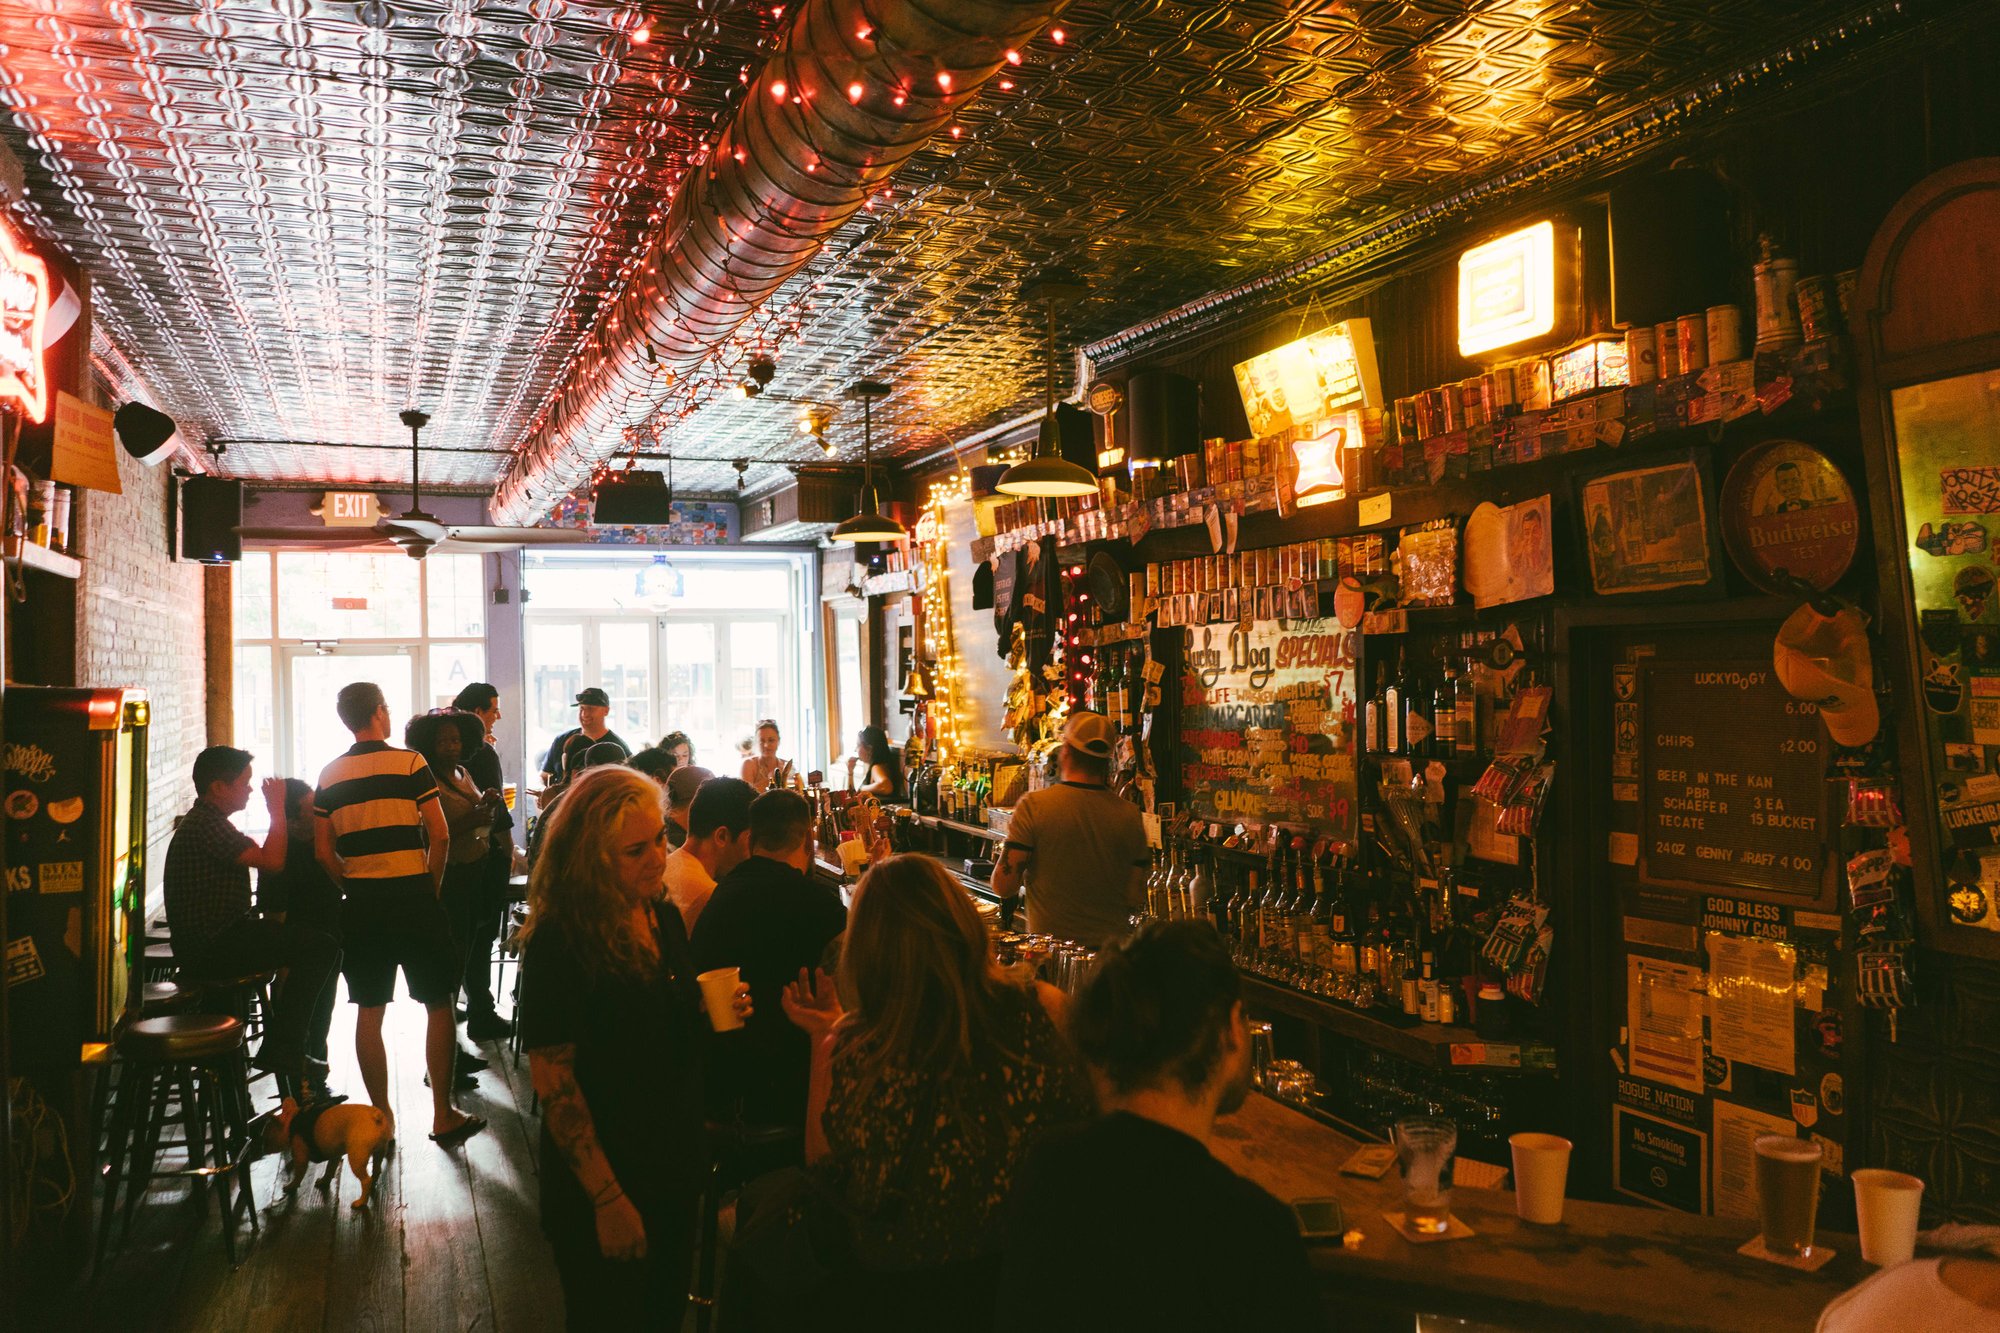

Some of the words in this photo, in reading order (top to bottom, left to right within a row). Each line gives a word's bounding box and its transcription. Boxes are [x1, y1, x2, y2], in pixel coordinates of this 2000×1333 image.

[334, 494, 369, 518] EXIT
[1790, 545, 1823, 560] TEST
[1230, 624, 1275, 690] Dog
[1275, 631, 1356, 669] SPECIALS
[1323, 670, 1343, 697] $7
[1695, 672, 1767, 690] LUCKYDOGY
[1785, 702, 1816, 715] 6.00
[1657, 734, 1695, 748] CHIPS
[1657, 770, 1687, 783] BEER
[1697, 772, 1709, 784] IN
[1714, 773, 1738, 787] THE
[1747, 775, 1773, 789] KAN
[1214, 789, 1263, 815] GILMORE
[1686, 787, 1710, 800] PBR
[1663, 797, 1728, 815] SCHAEFER
[1754, 796, 1762, 810] 3
[1766, 798, 1784, 811] EA
[1659, 814, 1705, 830] TECATE
[1750, 813, 1764, 826] 15
[1768, 814, 1816, 831] BUCKET
[1696, 846, 1733, 862] GENNY
[1707, 897, 1734, 915] GOD
[1738, 901, 1780, 921] BLESS
[1701, 914, 1749, 933] JOHNNY
[1752, 920, 1787, 939] CASH
[1618, 1079, 1650, 1100] ROGUE
[1655, 1089, 1694, 1113] NATION
[1633, 1127, 1645, 1142] No
[1648, 1131, 1685, 1158] Smoking
